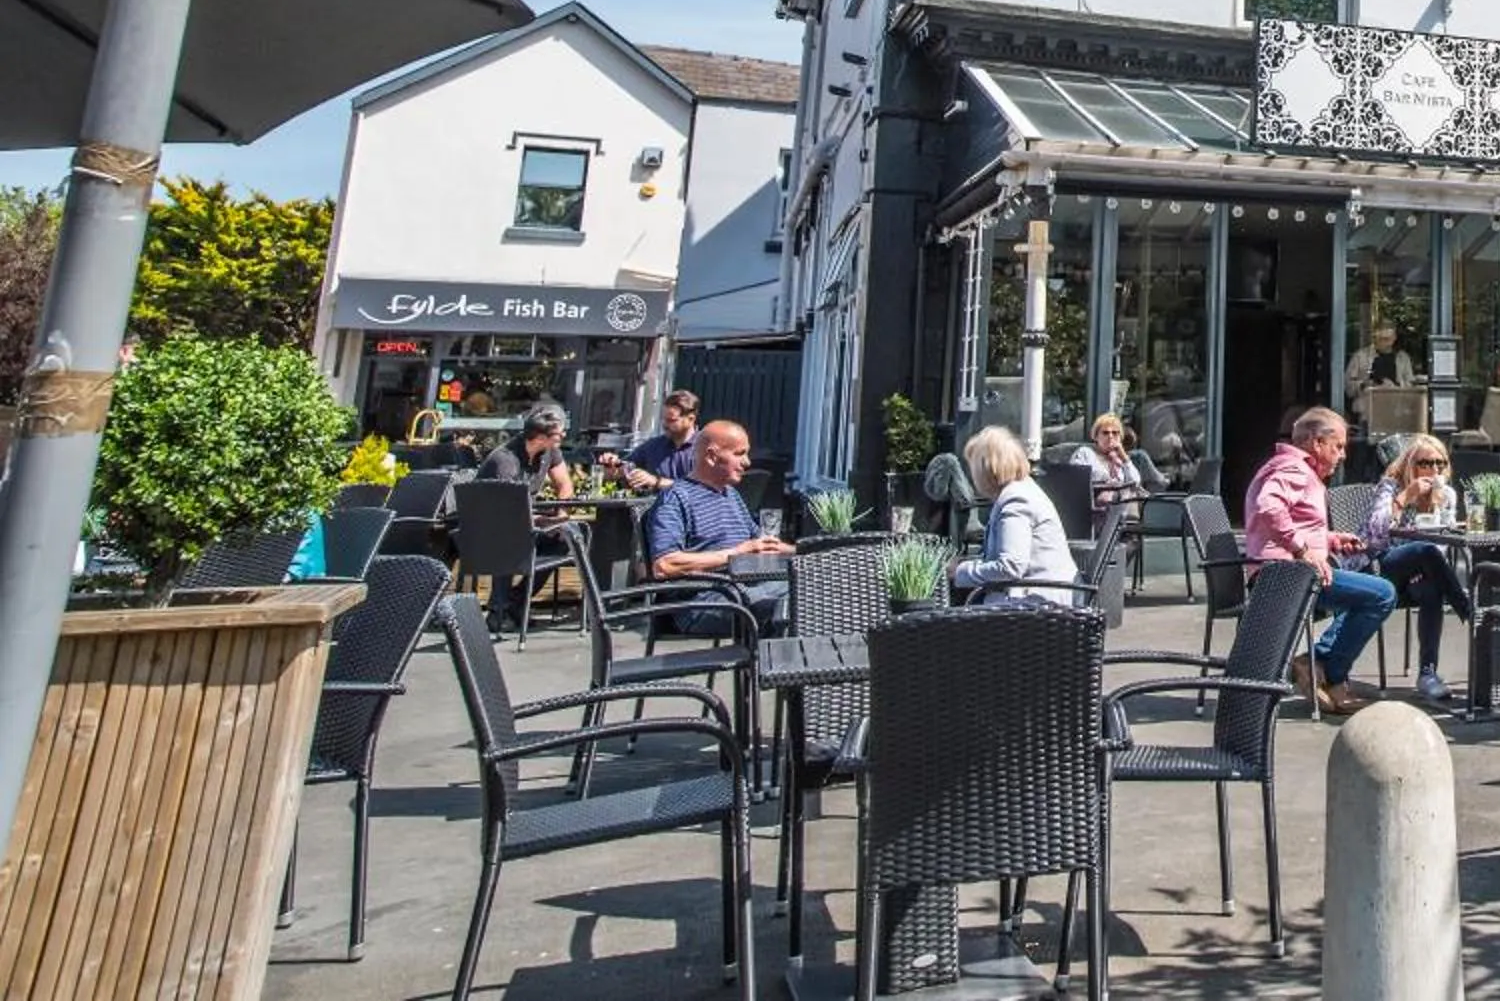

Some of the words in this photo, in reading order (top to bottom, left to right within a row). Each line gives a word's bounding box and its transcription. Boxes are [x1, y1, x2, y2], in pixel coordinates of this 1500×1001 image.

[503, 298, 545, 317] Fish
[553, 301, 590, 318] Bar
[377, 341, 417, 353] OPEN
